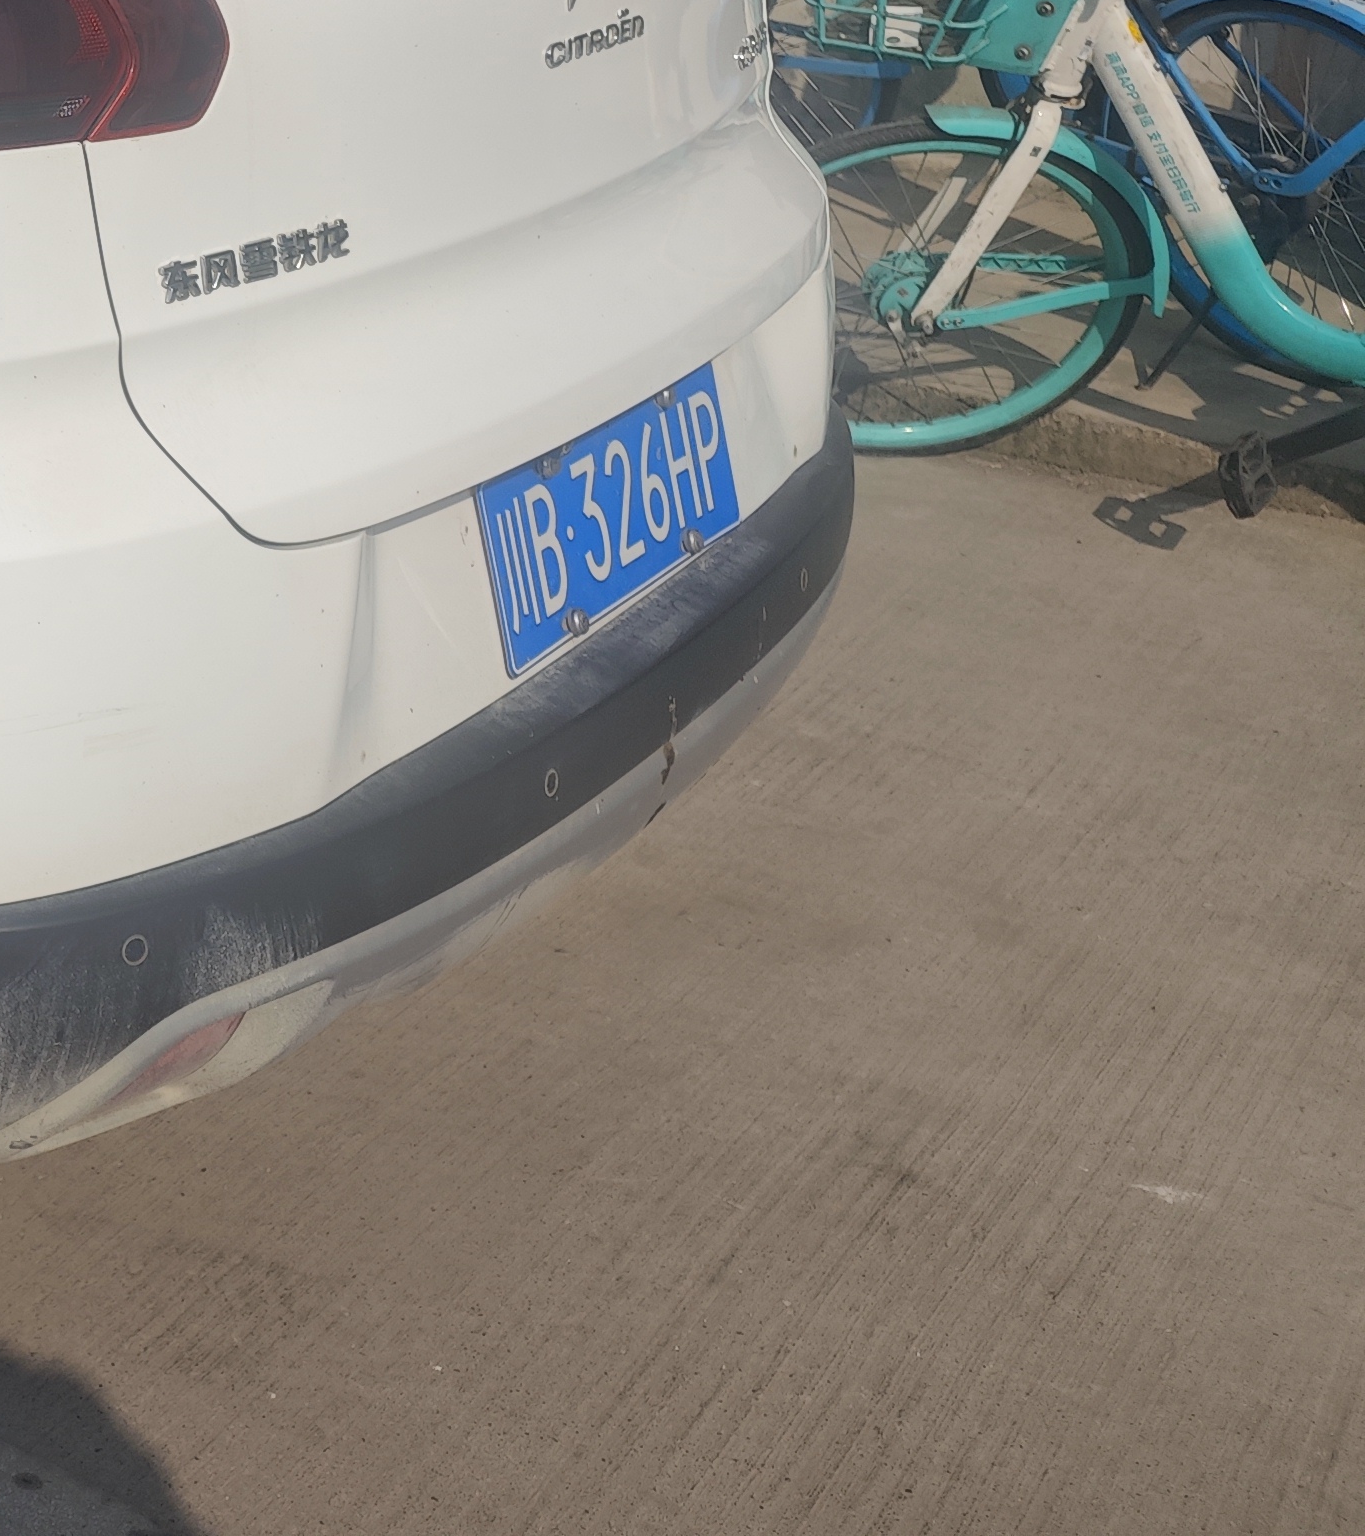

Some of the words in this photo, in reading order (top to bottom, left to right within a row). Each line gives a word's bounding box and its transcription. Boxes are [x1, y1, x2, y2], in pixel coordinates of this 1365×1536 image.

[158, 218, 351, 305] 东风雪铁龙
